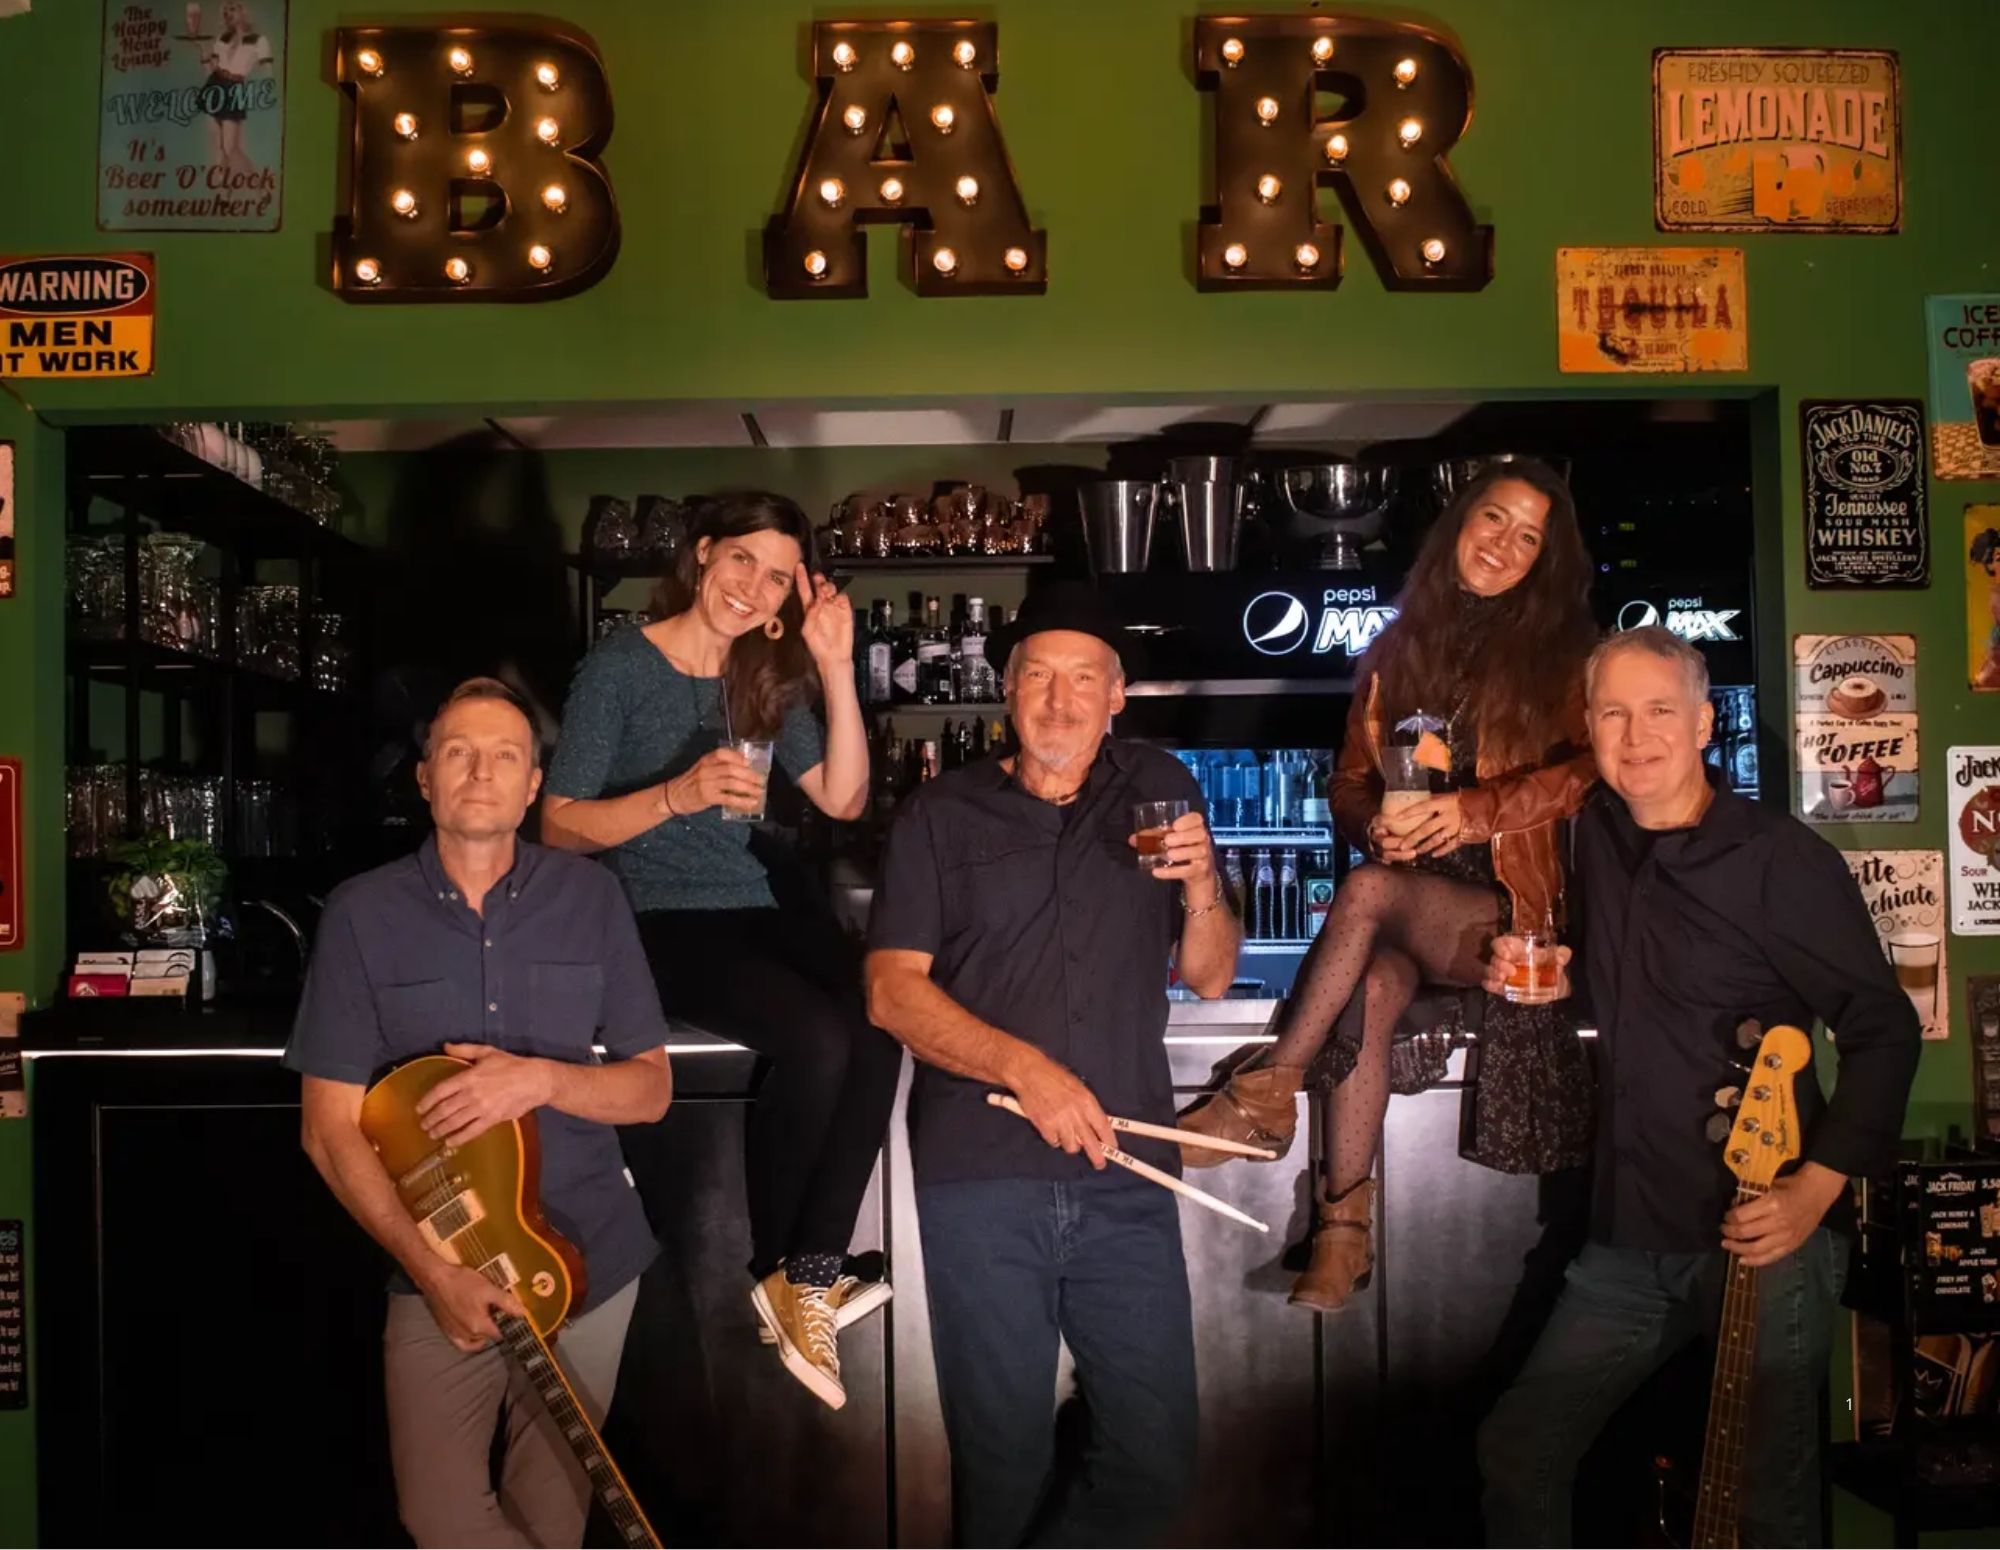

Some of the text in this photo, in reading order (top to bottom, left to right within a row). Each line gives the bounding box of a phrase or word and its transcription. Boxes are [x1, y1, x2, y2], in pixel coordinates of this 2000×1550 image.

[125, 6, 152, 21] The
[112, 19, 167, 37] Happy
[120, 37, 162, 52] Hour
[111, 51, 171, 72] Lounge
[1688, 61, 1870, 84] FRESHLY SQUEEZED
[106, 77, 278, 126] WELCOME
[1669, 86, 1889, 160] LEMONADE
[128, 138, 166, 162] It's
[333, 11, 1493, 303] BAR
[105, 164, 275, 190] Beer O'Clock
[123, 192, 272, 217] somewhere
[0, 269, 134, 302] WARNING
[1964, 304, 2000, 324] ICE
[10, 321, 112, 347] MEN
[0, 351, 139, 373] T WORK
[1813, 409, 1914, 449] JACK DANIEL'S
[1852, 450, 1878, 461] Old
[1825, 493, 1908, 517] Tennessee
[1825, 518, 1910, 527] SOUR MASH
[1817, 528, 1917, 547] WHISKEY
[1323, 585, 1376, 605] pepsi
[1668, 596, 1702, 610] pepsi
[1666, 610, 1741, 641] MAX
[1825, 639, 1883, 656] CLASSIC
[1810, 656, 1904, 683] Cappuccino
[1804, 732, 1838, 748] HOT
[1816, 737, 1904, 765] COFFEE
[1972, 810, 2000, 832] N
[1854, 857, 1897, 885] tte
[1870, 883, 1938, 916] chiato
[1926, 1181, 1947, 1193] JACK
[1948, 1180, 1976, 1192] FRIDAY
